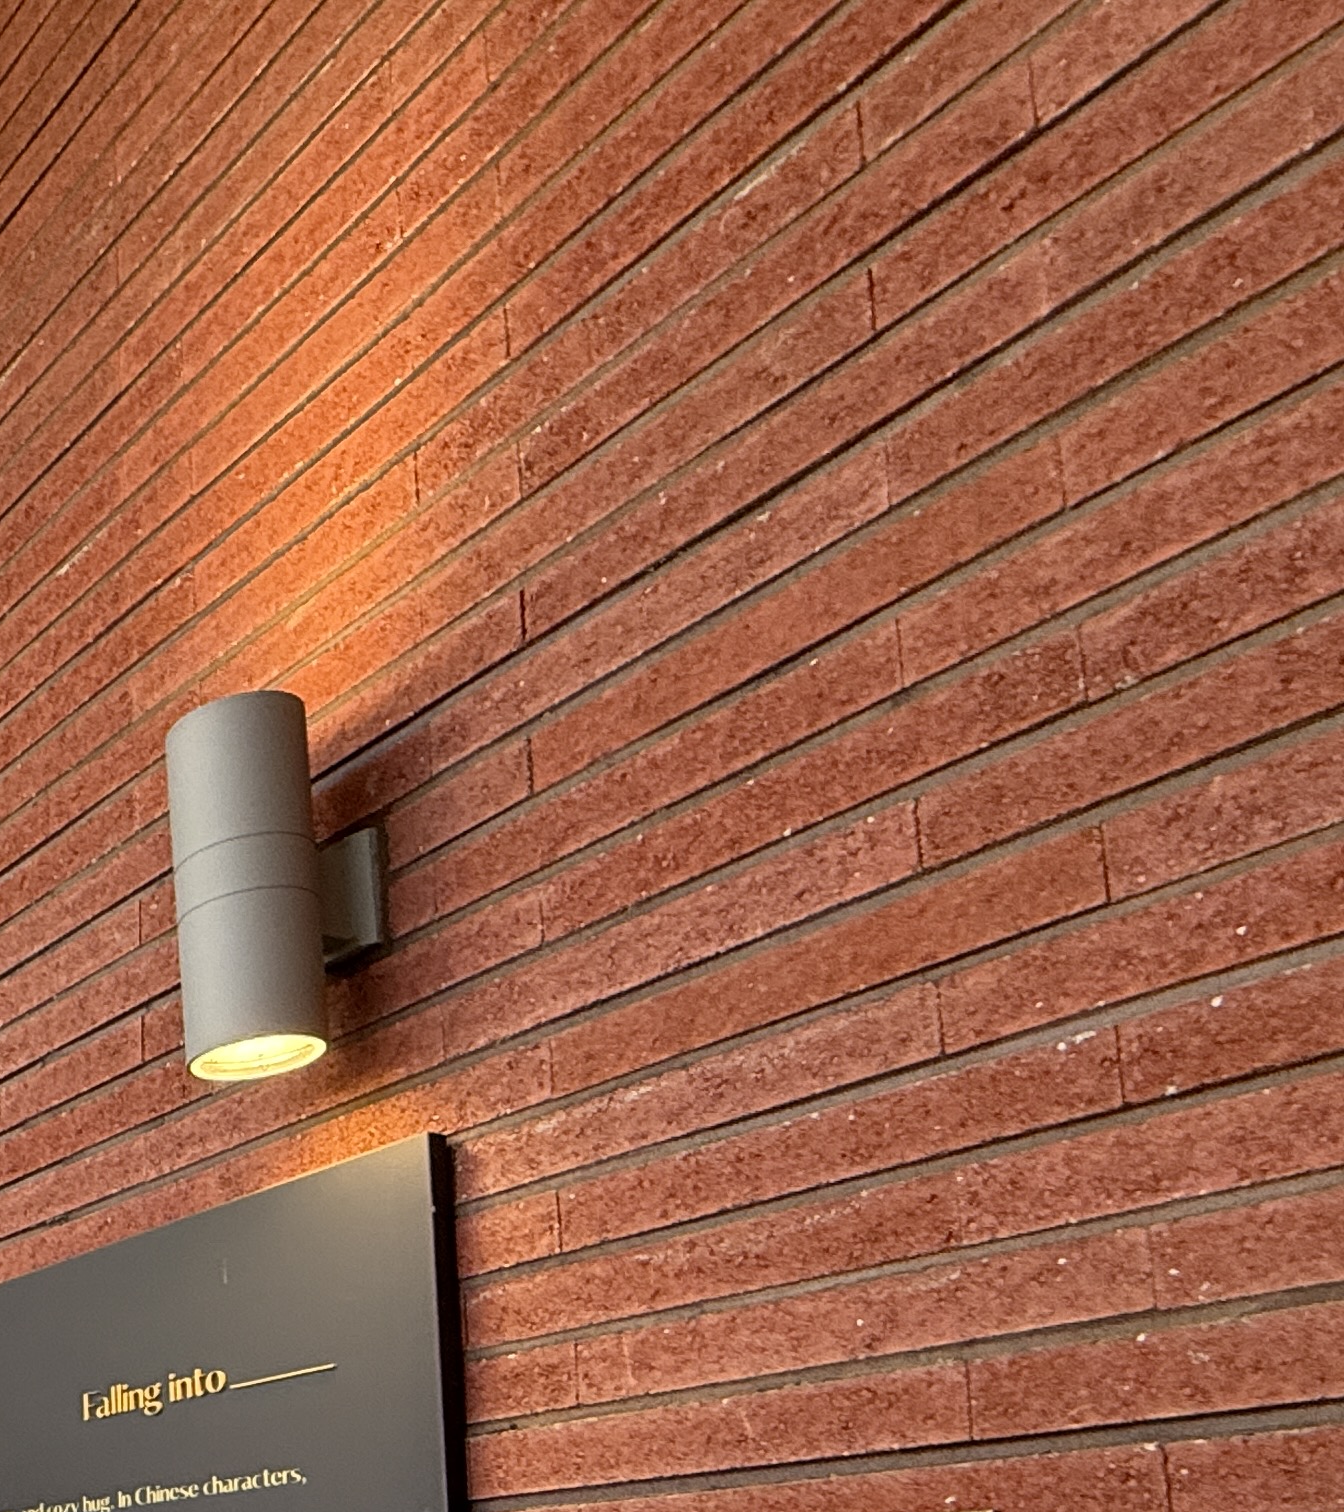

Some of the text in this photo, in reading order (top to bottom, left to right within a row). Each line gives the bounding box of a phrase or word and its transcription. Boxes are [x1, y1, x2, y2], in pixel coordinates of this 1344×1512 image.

[82, 1382, 163, 1421] Falling
[118, 1490, 132, 1508] In
[135, 1483, 200, 1506] Chinese
[203, 1467, 308, 1496] characters,
